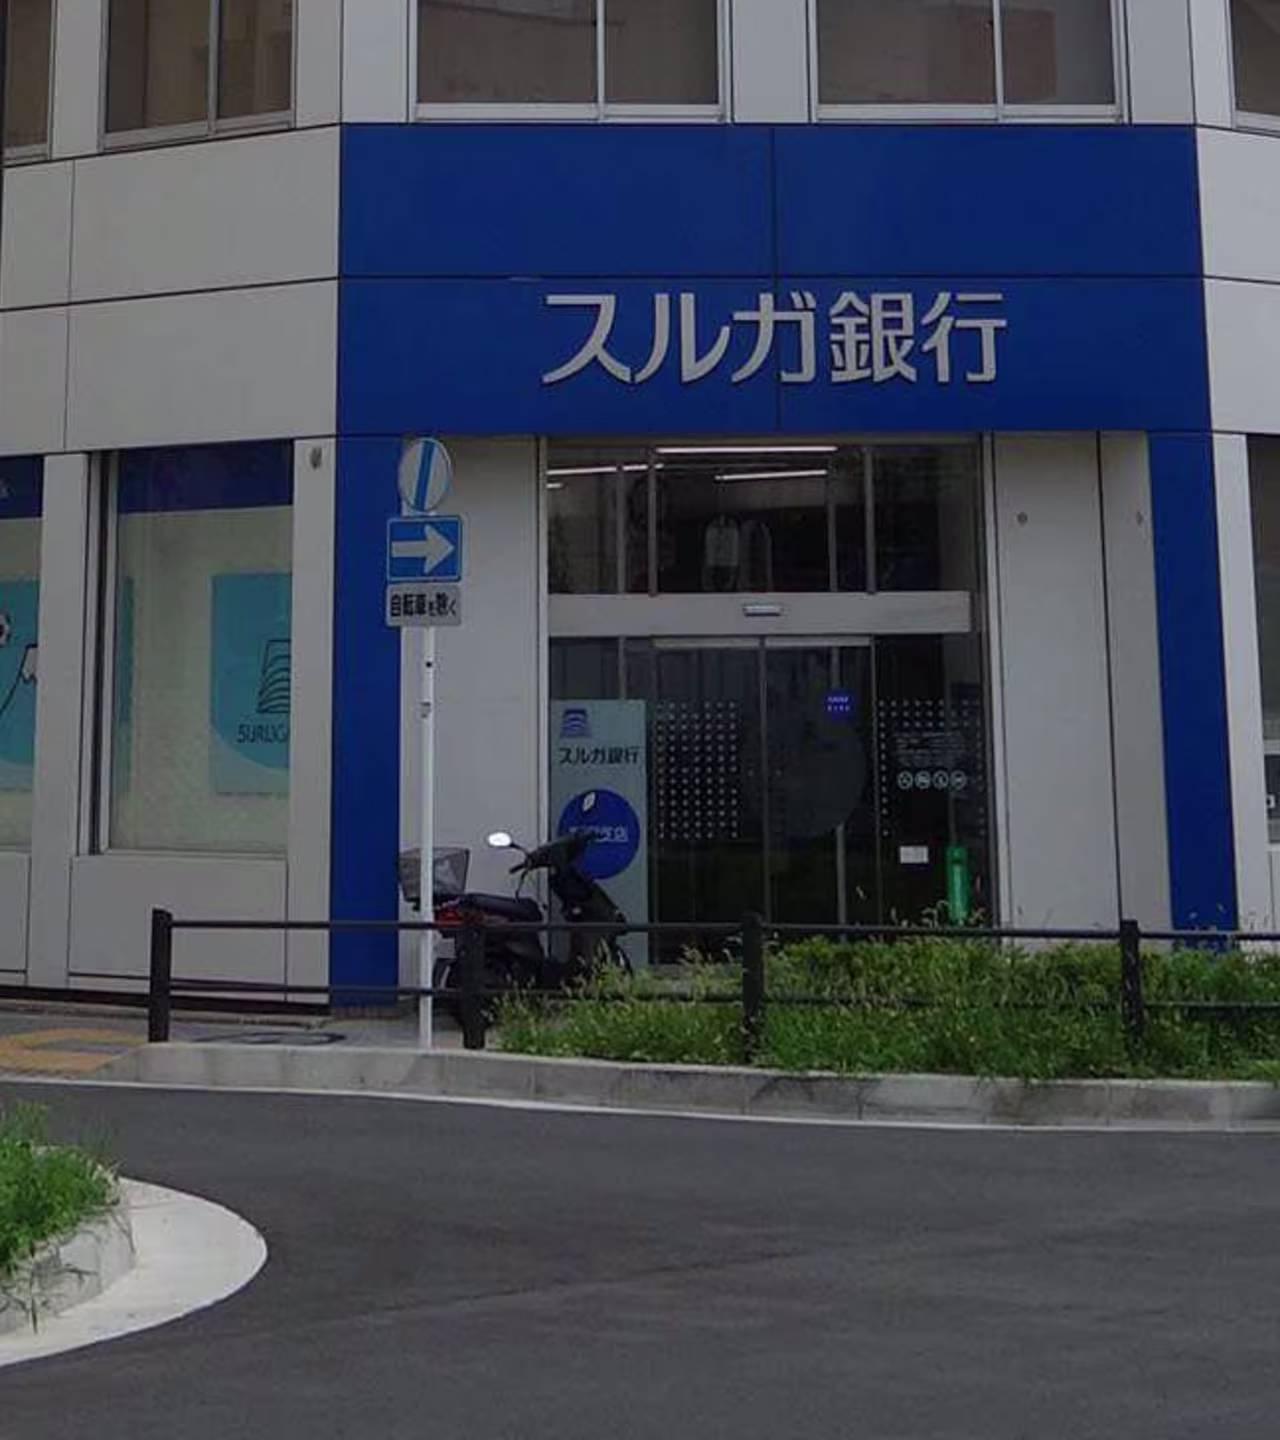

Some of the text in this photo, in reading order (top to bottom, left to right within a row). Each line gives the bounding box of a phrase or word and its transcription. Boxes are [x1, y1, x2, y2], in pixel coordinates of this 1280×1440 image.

[541, 291, 1008, 384] スルガ銀行
[390, 591, 457, 617] 自転車を除く
[559, 746, 640, 765] スルガ銀行
